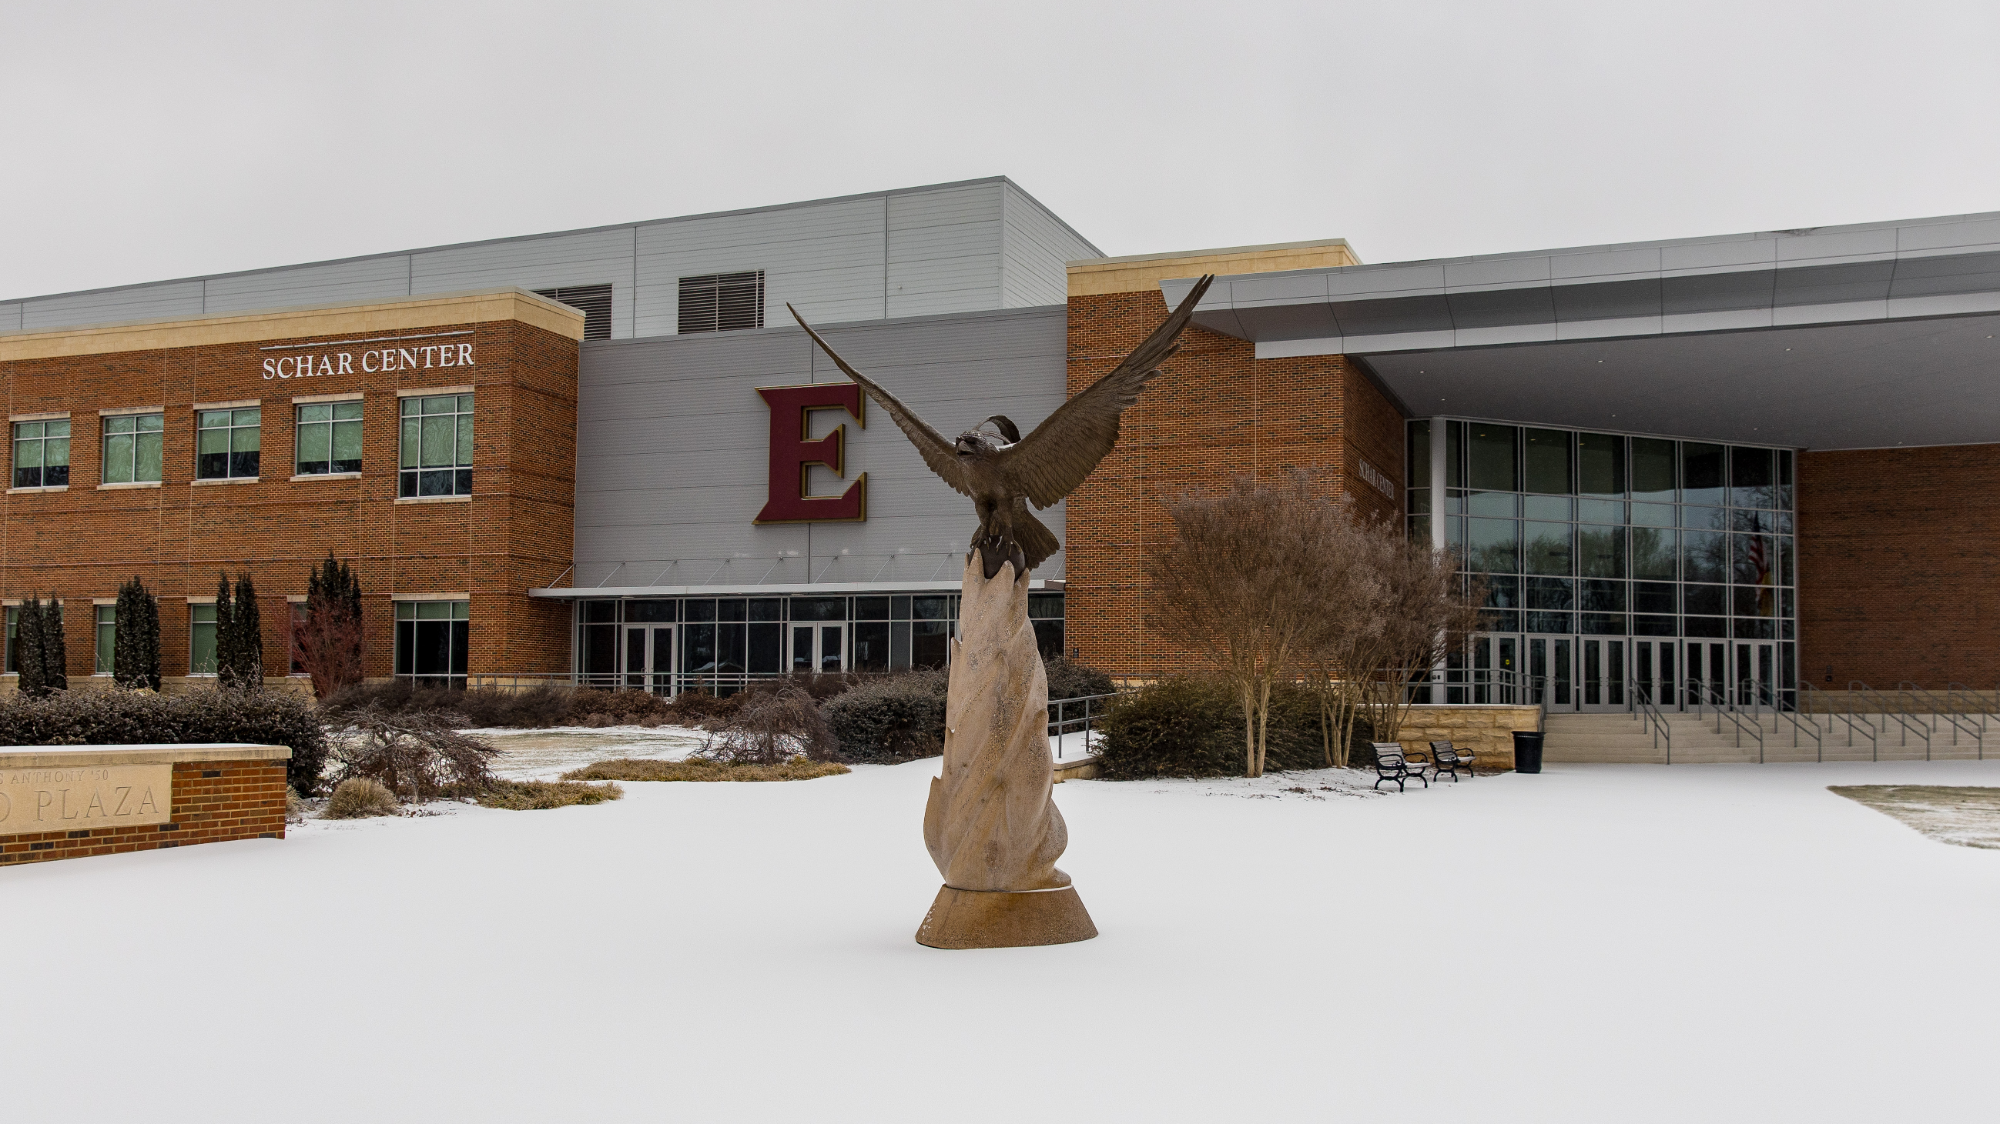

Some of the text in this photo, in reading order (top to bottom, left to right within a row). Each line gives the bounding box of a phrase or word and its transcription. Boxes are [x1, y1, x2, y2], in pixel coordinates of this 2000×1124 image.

[263, 343, 475, 380] SCHAR CENTER
[752, 381, 867, 525] E
[10, 770, 84, 784] ANTHONY
[33, 786, 159, 822] PLAZA
